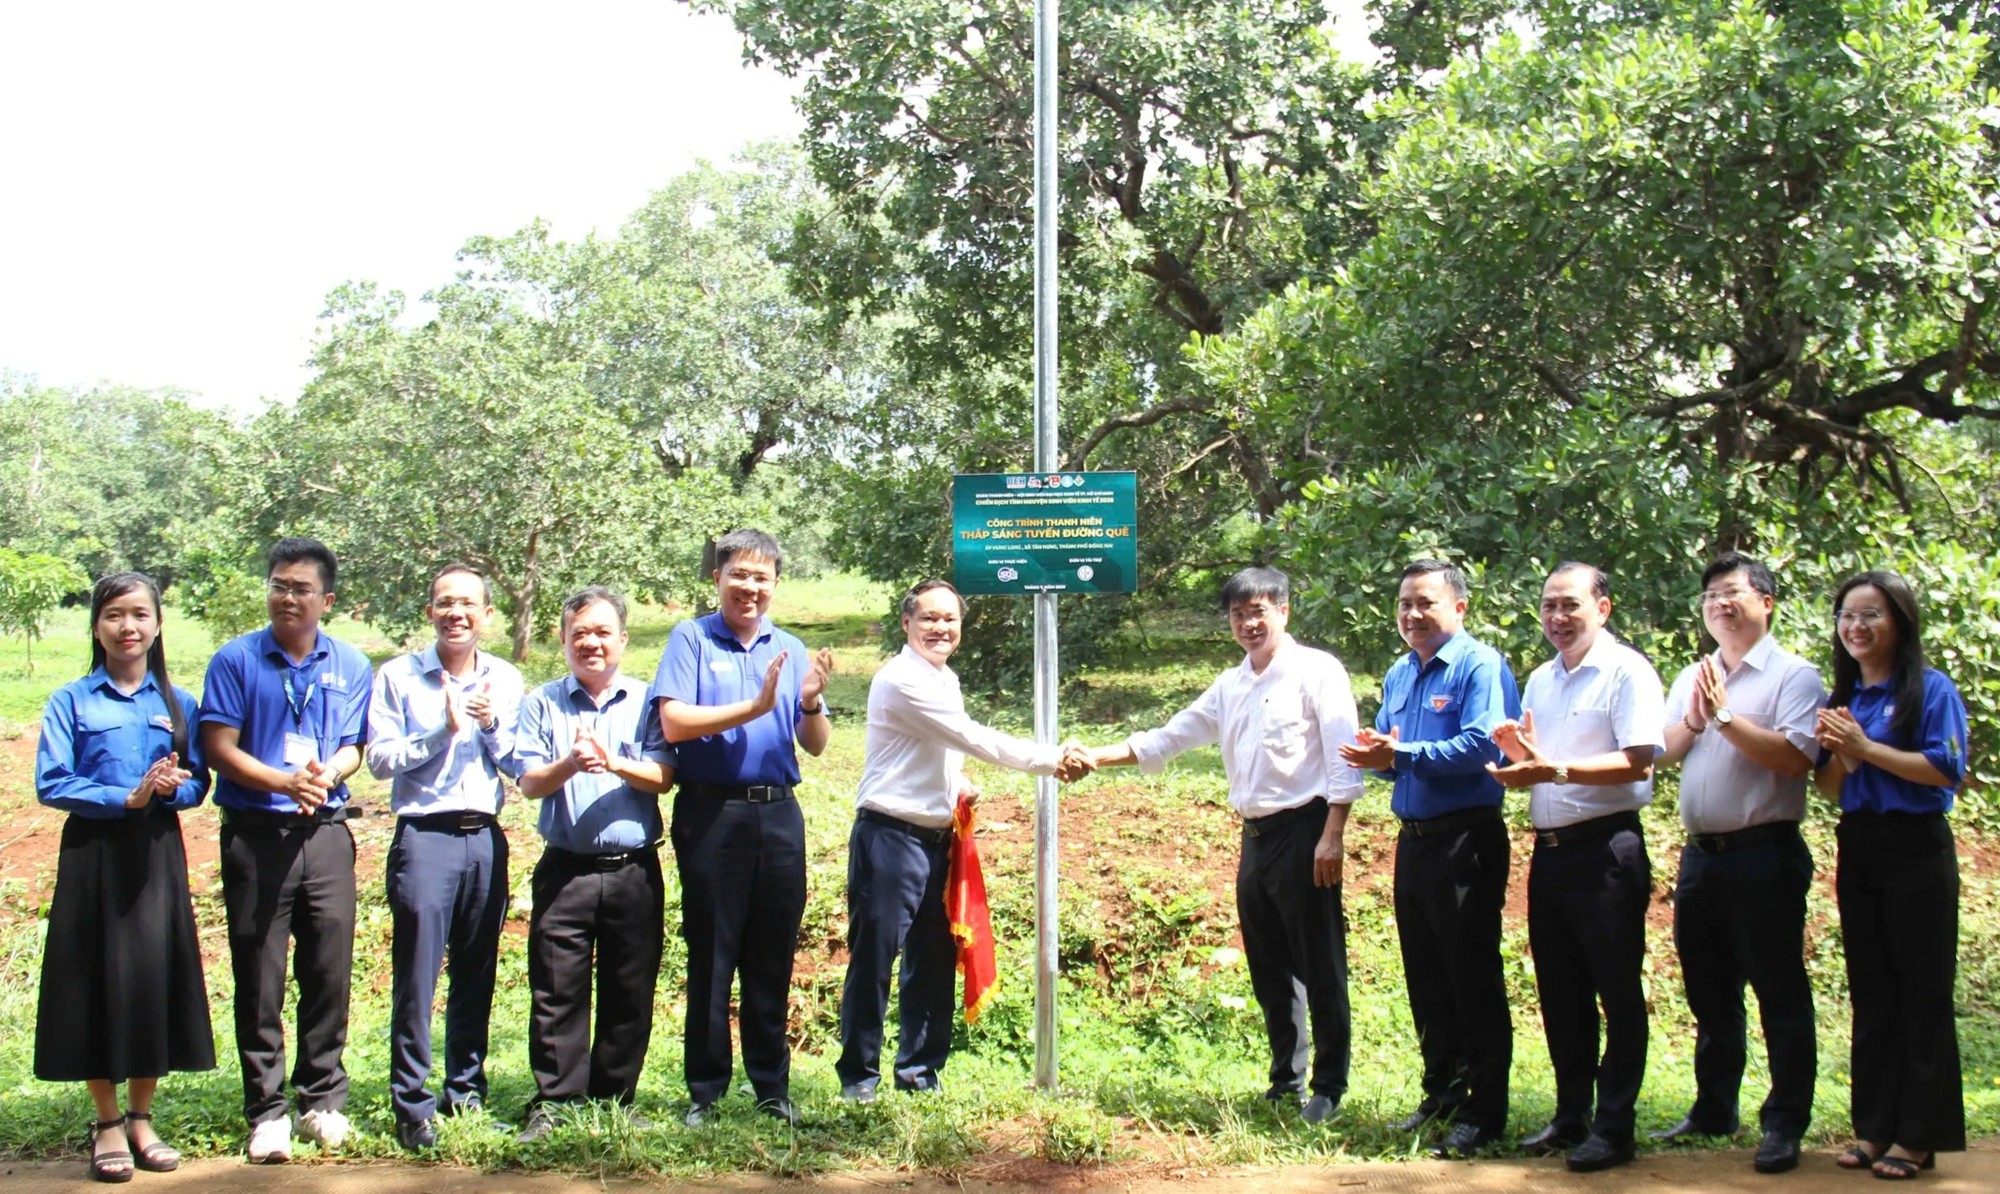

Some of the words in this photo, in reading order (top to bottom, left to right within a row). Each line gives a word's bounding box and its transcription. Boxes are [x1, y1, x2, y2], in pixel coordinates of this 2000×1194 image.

[986, 518, 1013, 527] CÔNG
[1015, 518, 1043, 527] TRÌNH
[1046, 518, 1078, 526] THANH
[1080, 516, 1102, 525] NIÊN
[961, 528, 990, 539] THẮP
[992, 528, 1022, 539] SÁNG
[1024, 527, 1060, 538] TUYẾN
[1062, 527, 1103, 537] ĐƯỜNG
[1106, 526, 1129, 538] QUÊ
